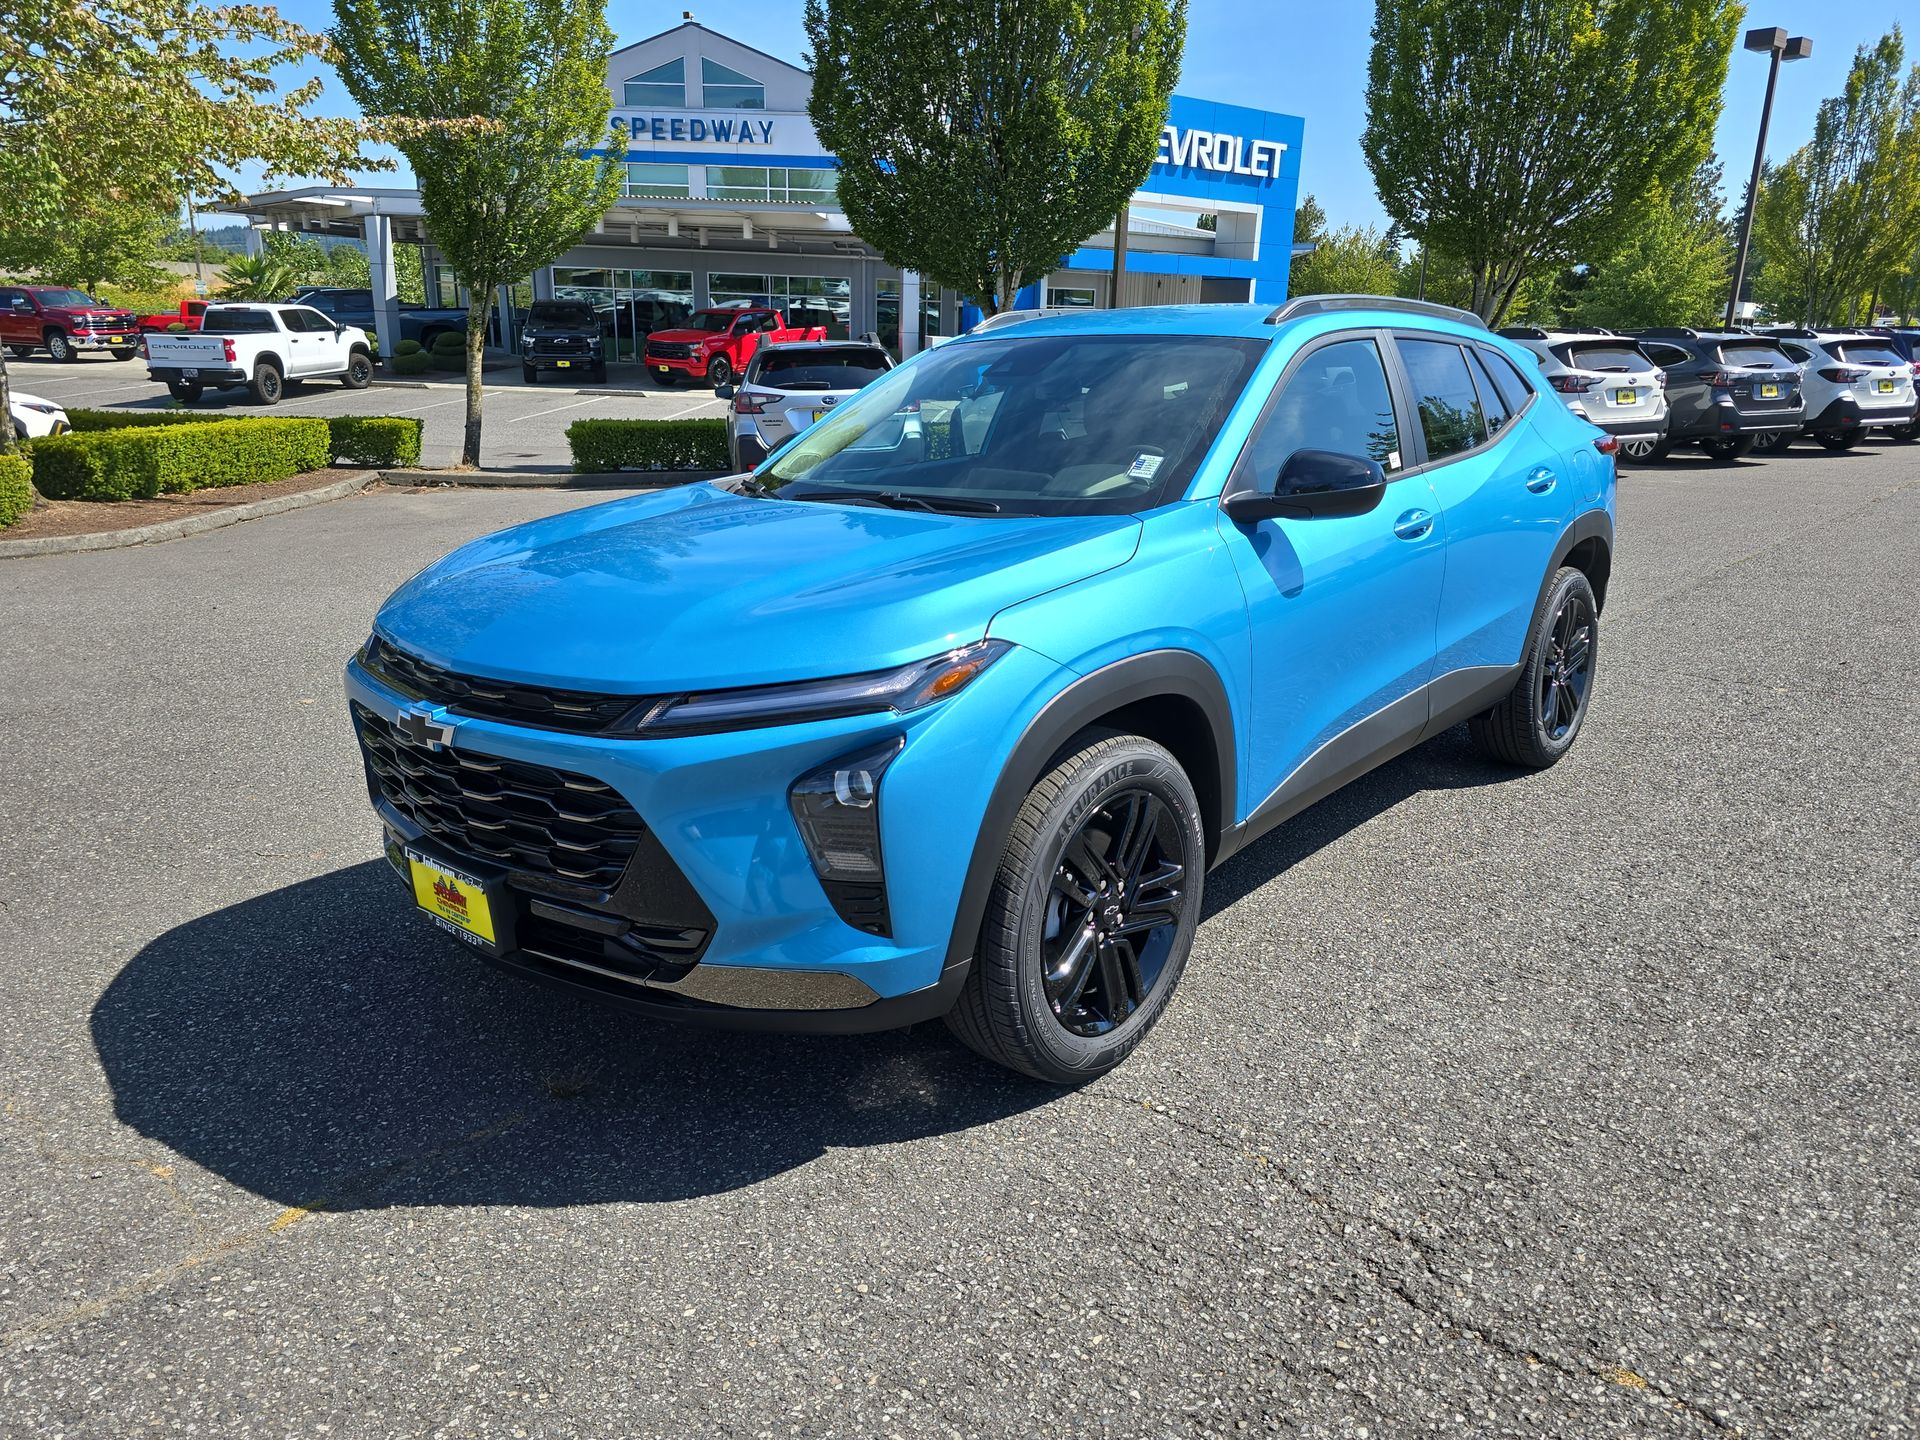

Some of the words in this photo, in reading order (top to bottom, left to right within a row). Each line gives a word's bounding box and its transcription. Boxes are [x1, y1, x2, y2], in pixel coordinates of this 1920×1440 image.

[1058, 761, 1134, 843] ASSURANCE
[422, 855, 456, 879] Johnson
[436, 918, 457, 935] SINCE
[459, 930, 477, 945] 1933
